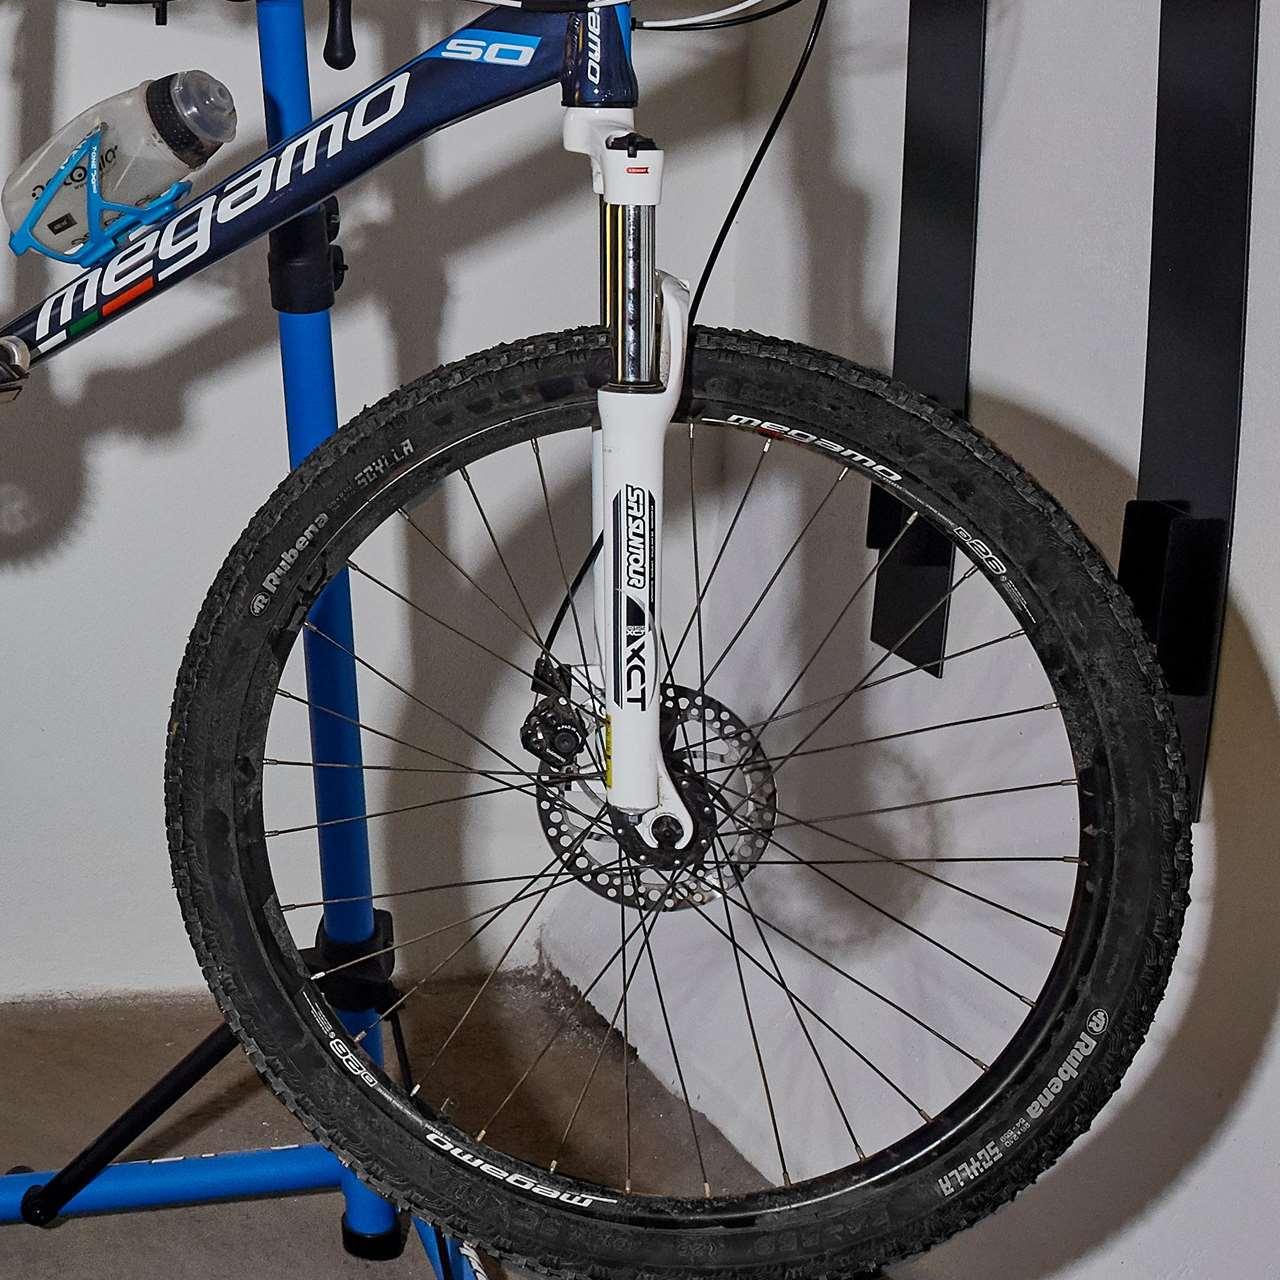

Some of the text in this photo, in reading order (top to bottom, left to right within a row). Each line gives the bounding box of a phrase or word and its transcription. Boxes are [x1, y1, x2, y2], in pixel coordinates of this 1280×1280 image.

[35, 72, 411, 352] megamo
[726, 414, 903, 482] megamo
[261, 512, 329, 593] Rubena
[626, 639, 646, 712] XCT
[1025, 1031, 1097, 1119] Rubena
[425, 1132, 593, 1207] megamo
